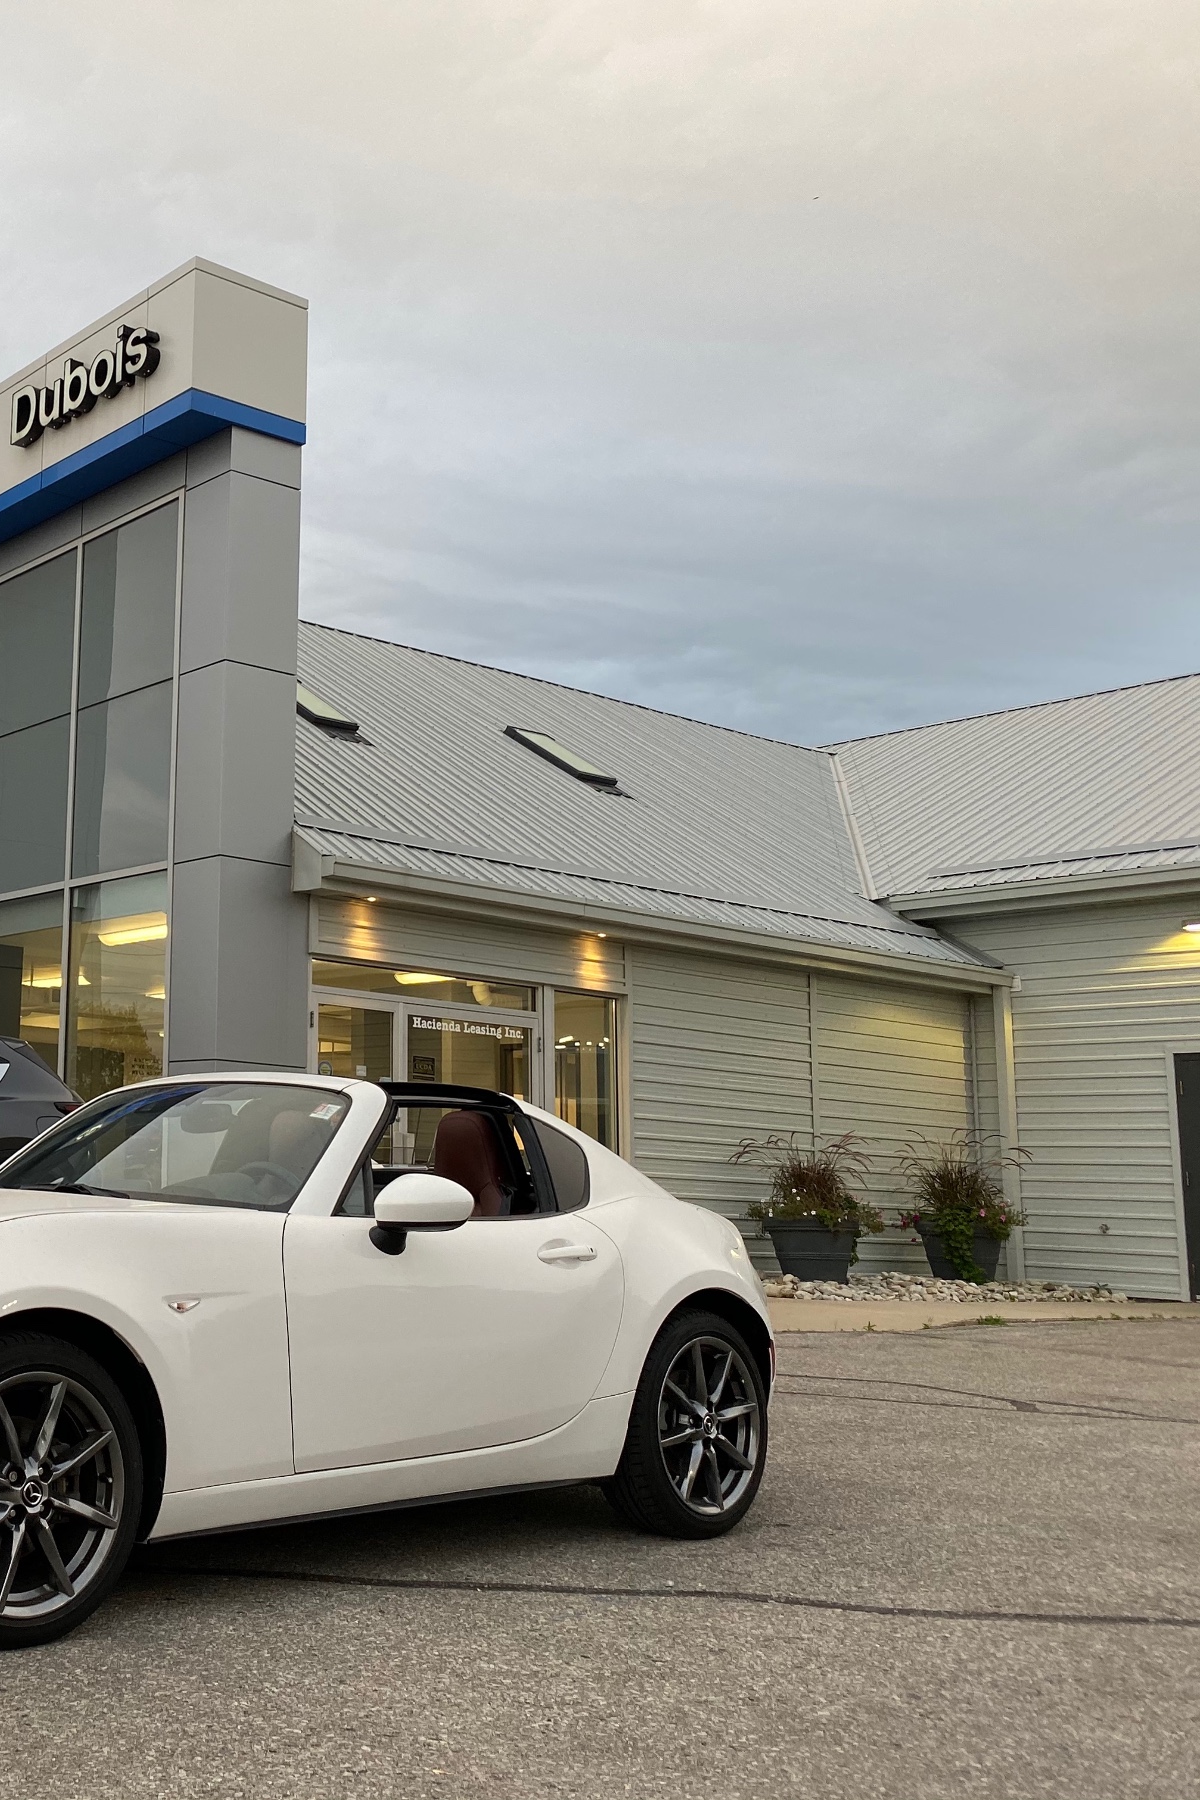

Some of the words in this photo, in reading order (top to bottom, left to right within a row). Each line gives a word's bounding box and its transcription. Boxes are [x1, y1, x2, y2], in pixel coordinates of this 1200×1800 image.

[11, 325, 158, 446] Dubois
[412, 1017, 461, 1032] Hacienda
[463, 1022, 502, 1039] Leasing
[504, 1027, 524, 1039] Inc.
